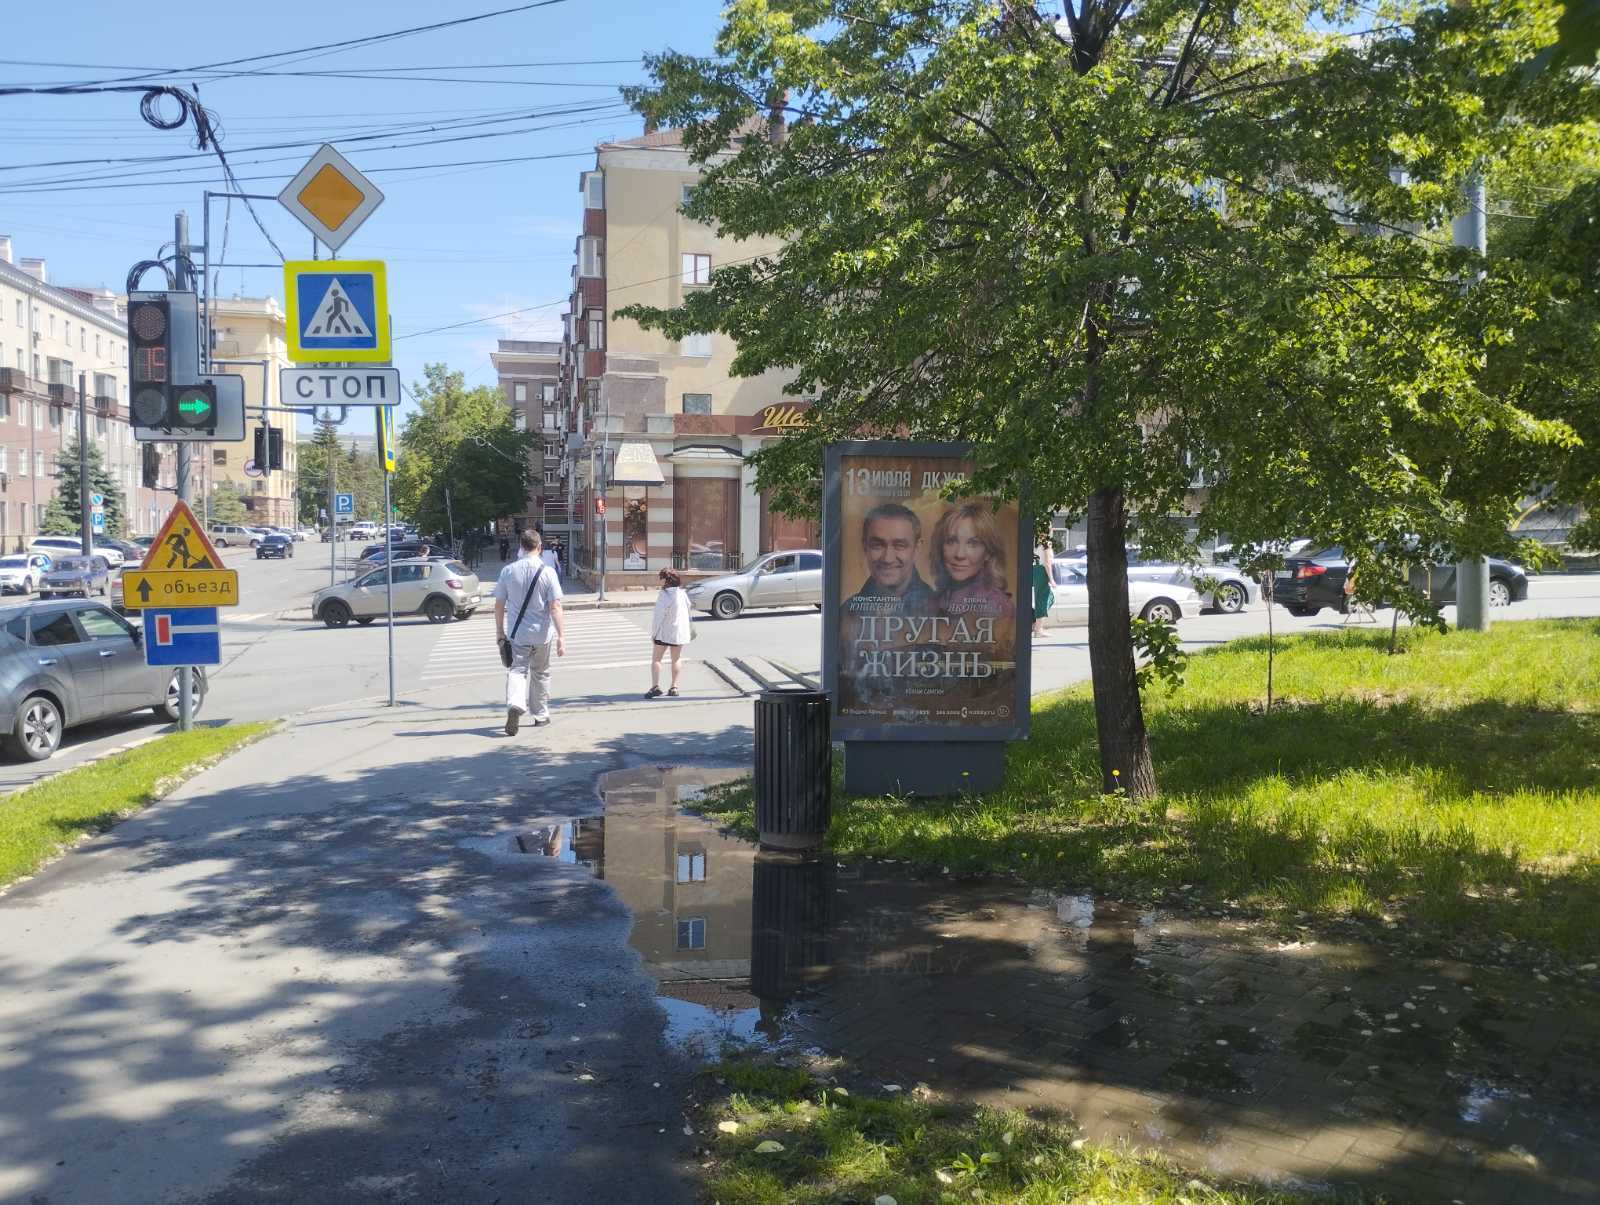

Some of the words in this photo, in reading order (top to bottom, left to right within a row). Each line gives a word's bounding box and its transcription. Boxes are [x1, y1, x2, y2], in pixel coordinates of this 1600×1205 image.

[296, 375, 386, 399] СТОП
[846, 468, 870, 497] 13
[872, 471, 911, 488] ИЮЛЯ
[921, 471, 940, 489] ДК
[338, 496, 350, 511] P
[163, 579, 231, 594] объезд
[855, 616, 996, 649] ДРУГАЯ
[859, 650, 992, 678] ЖИЗНЬ
